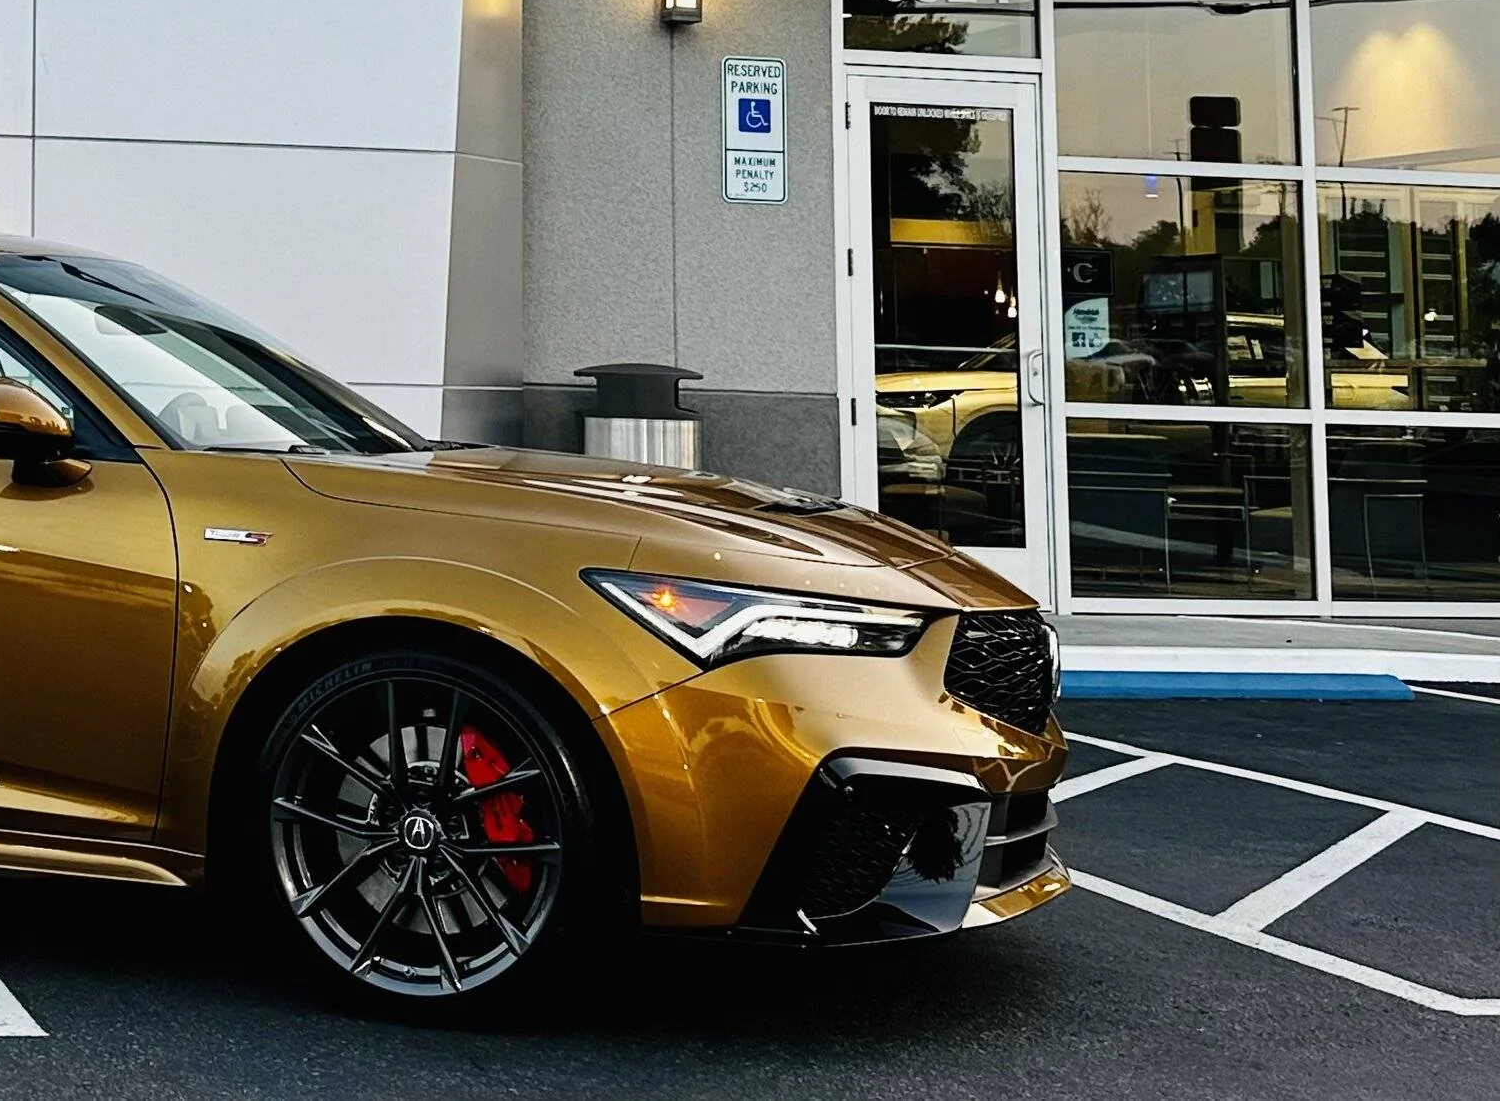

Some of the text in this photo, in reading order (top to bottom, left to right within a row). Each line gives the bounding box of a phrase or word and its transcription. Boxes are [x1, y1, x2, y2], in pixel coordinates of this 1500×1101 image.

[727, 64, 781, 79] RESERVED
[731, 80, 778, 95] PARKING
[734, 156, 776, 168] MAXIMUM
[735, 168, 775, 180] PENALTY
